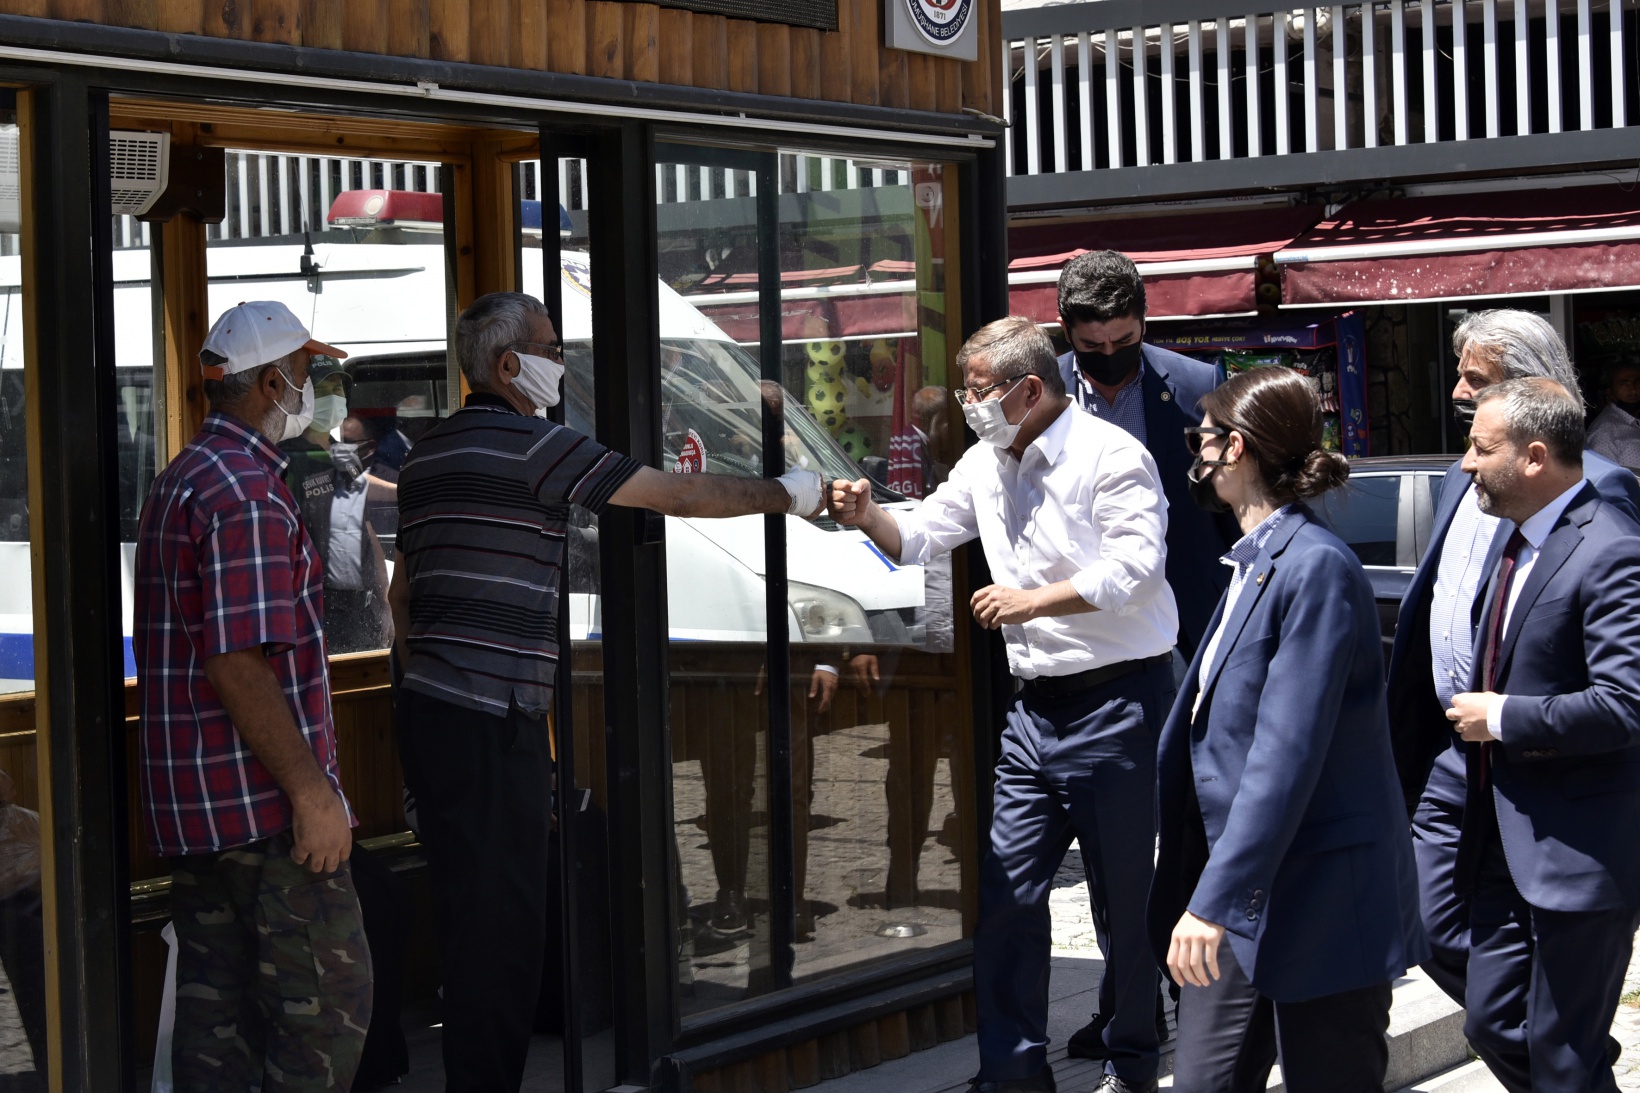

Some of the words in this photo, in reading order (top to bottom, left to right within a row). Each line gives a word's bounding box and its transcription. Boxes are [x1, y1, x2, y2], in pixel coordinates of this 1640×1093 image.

[934, 10, 946, 20] 1871
[941, 2, 968, 37] BELEDİYESİ
[1176, 336, 1192, 346] BOŞ
[1194, 336, 1210, 344] YOK
